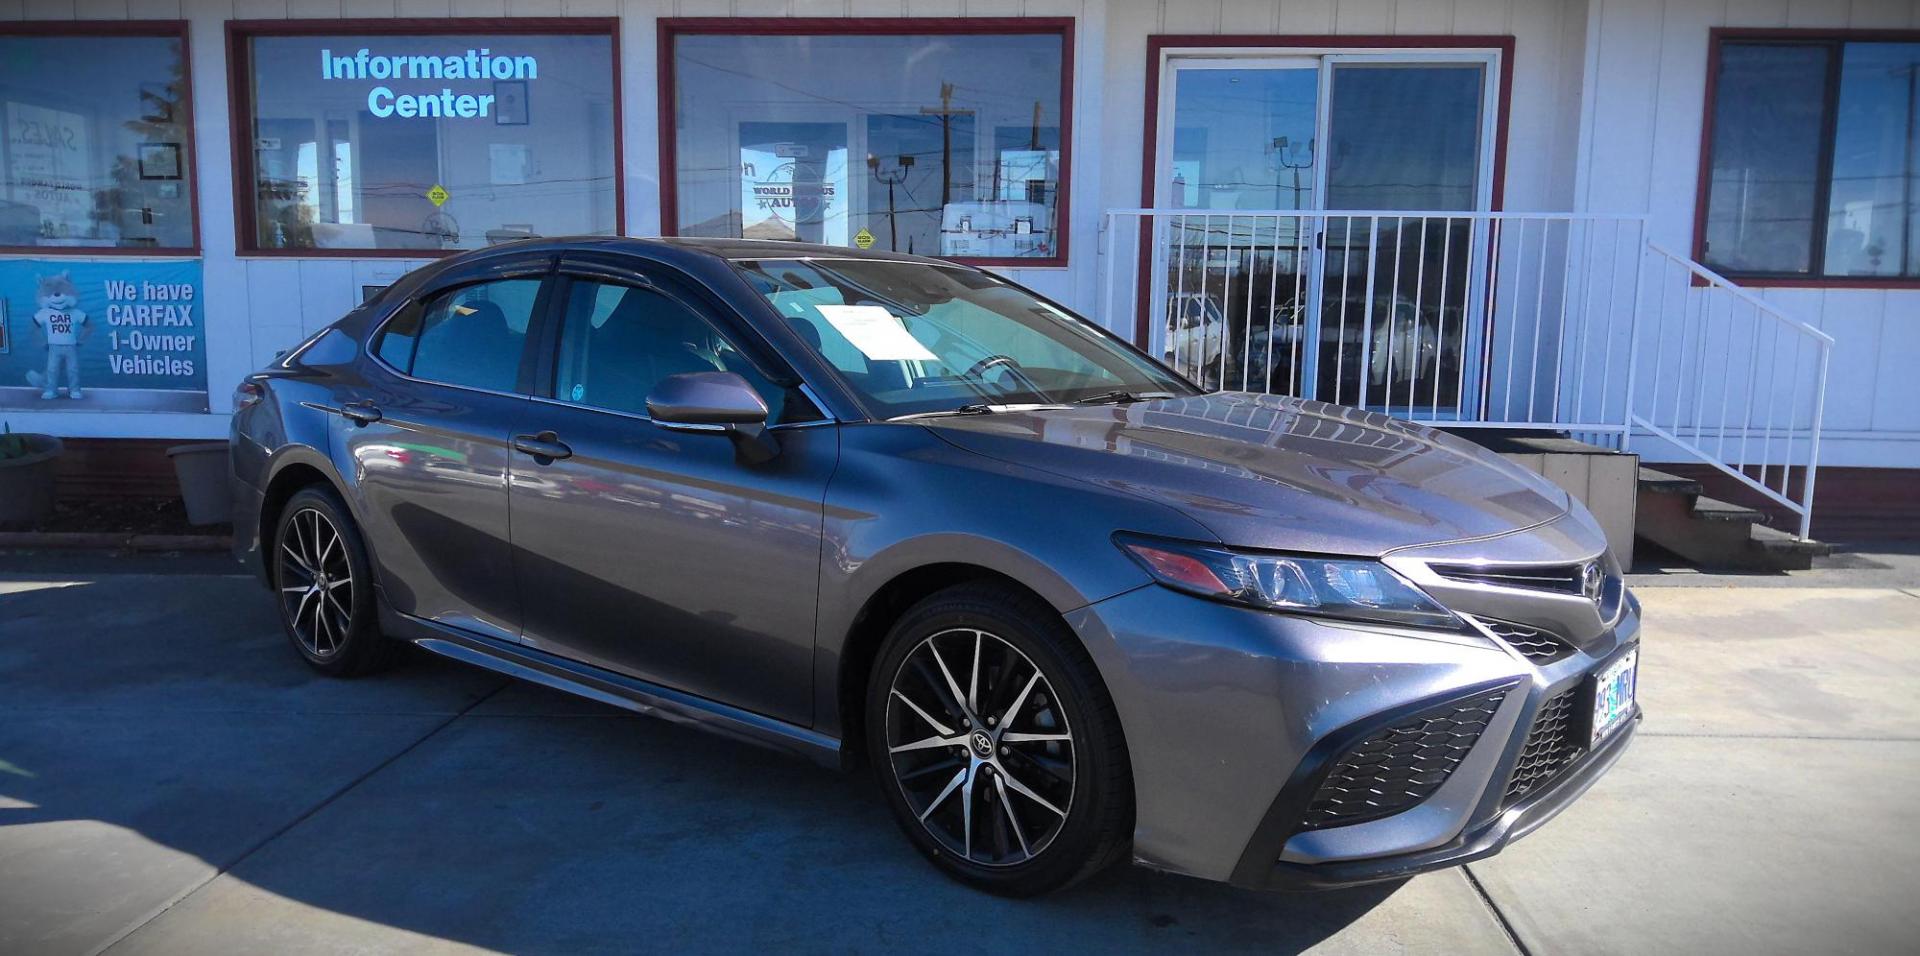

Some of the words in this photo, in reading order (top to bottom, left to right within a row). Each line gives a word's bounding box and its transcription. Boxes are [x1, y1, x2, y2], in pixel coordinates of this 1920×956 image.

[321, 48, 538, 79] Information
[367, 86, 496, 118] Center
[753, 187, 790, 196] WORLD
[104, 279, 137, 301] We
[143, 280, 193, 301] have
[49, 314, 71, 324] CAR
[106, 305, 193, 327] CARFAX
[52, 324, 72, 334] FOX
[109, 330, 196, 352] 1-Owner
[109, 355, 195, 376] Vehicles
